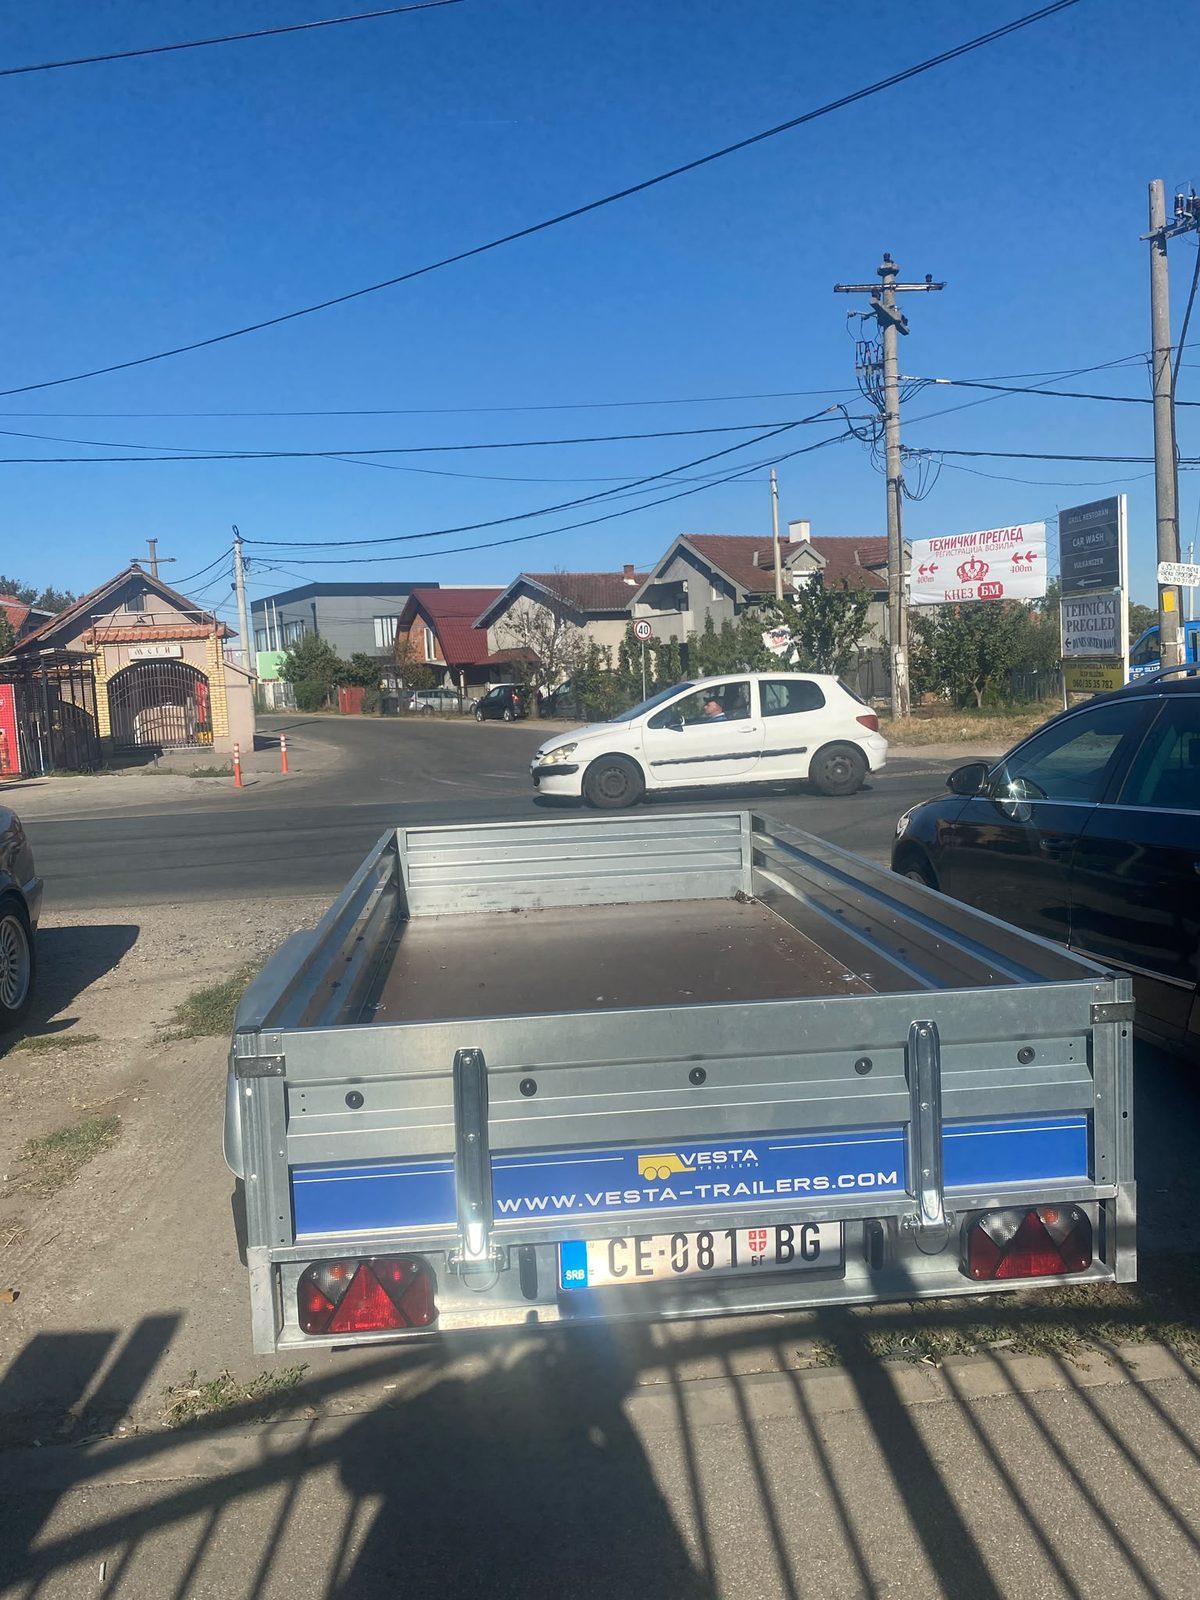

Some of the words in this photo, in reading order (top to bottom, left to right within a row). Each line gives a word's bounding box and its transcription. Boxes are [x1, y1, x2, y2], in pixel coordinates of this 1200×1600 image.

[929, 534, 977, 552] ТЕХНИЧКИ
[979, 527, 1024, 544] ПРЕГЛЕД
[1072, 538, 1084, 547] CAR
[1086, 533, 1104, 545] WASH
[1010, 564, 1033, 574] 400m
[944, 588, 974, 600] КНЕЗ
[981, 584, 1000, 596] БМ
[639, 625, 648, 634] 40
[1066, 618, 1115, 632] PREGLED
[1102, 680, 1114, 689] 782
[680, 1149, 759, 1166] VESTA
[700, 1162, 760, 1171] TRAILERS
[497, 1171, 898, 1212] WWW.VESTA-TRAILERS.COM
[775, 1222, 821, 1265] BG
[565, 1268, 585, 1281] SRB
